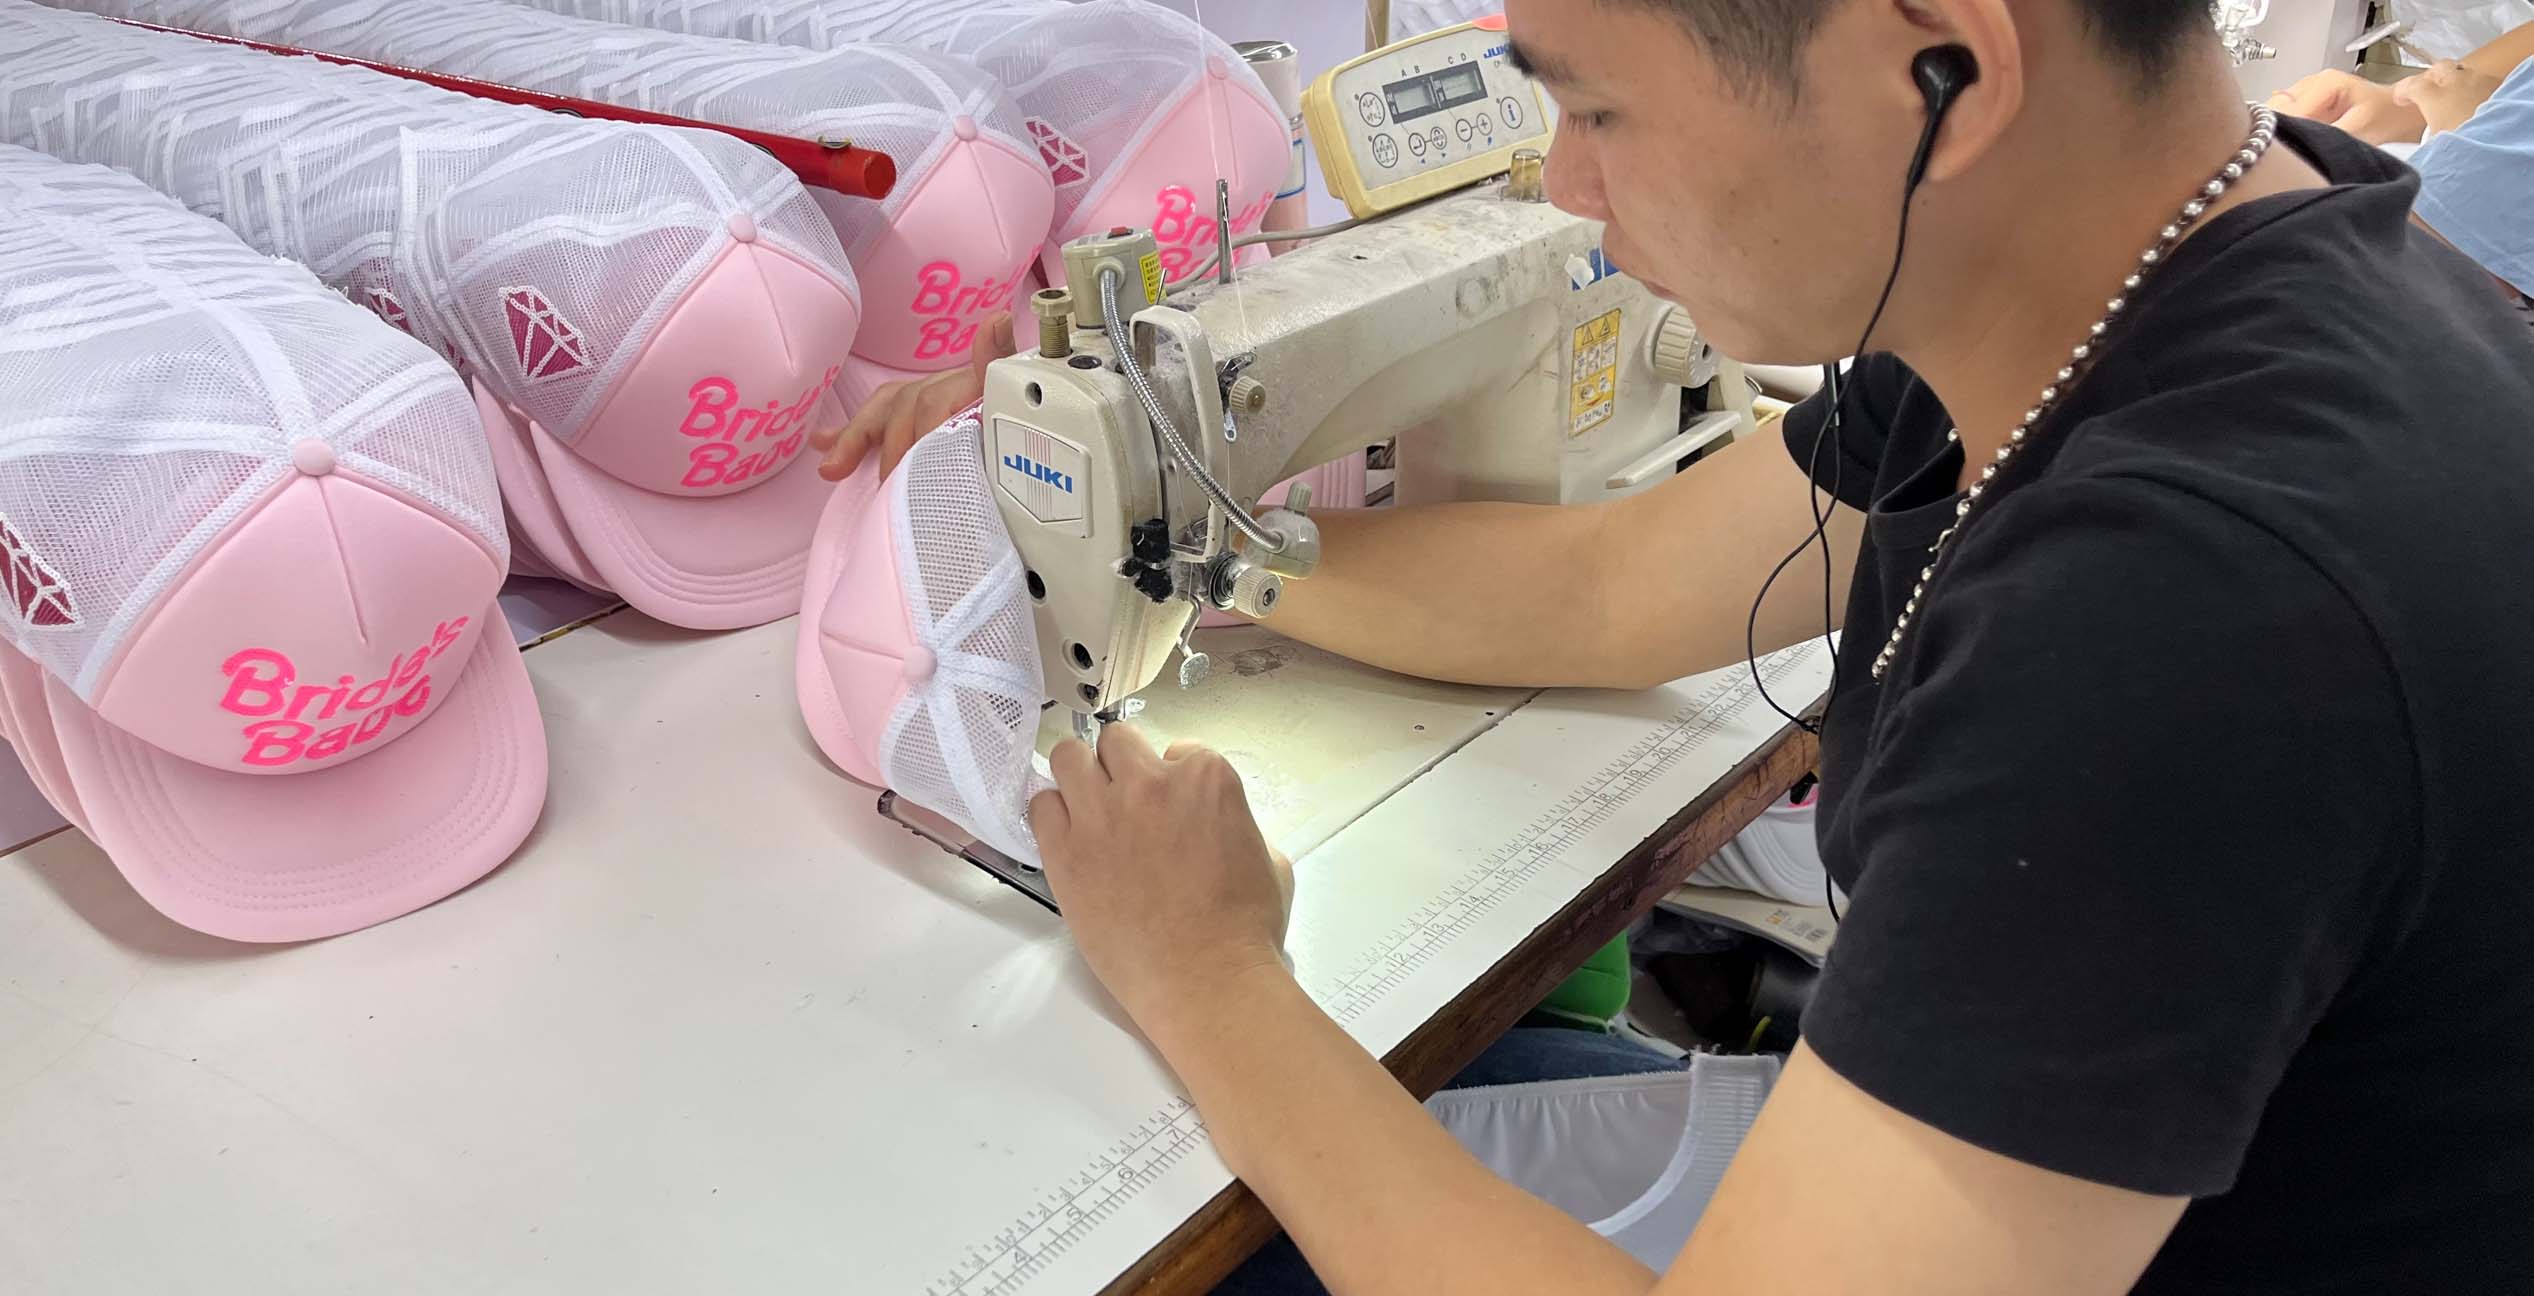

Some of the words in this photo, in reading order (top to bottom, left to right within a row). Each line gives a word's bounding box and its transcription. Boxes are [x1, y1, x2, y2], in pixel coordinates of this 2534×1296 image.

[1401, 69, 1407, 78] A
[1415, 65, 1421, 74] B
[1447, 56, 1454, 65] C
[1460, 52, 1467, 61] D
[914, 317, 980, 359] Ba
[1004, 454, 1073, 494] JUKI
[219, 615, 470, 720] Bride's
[1386, 952, 1408, 968] 12
[1423, 922, 1445, 938] 13
[1459, 895, 1480, 909] 14
[1494, 867, 1516, 881] 15
[1528, 842, 1549, 856] 16
[1561, 815, 1580, 830] 17
[1592, 792, 1613, 806] 18
[1623, 768, 1643, 782] 19
[1651, 746, 1672, 761] 20
[1707, 703, 1728, 717] 22
[1013, 1248, 1030, 1265] 4
[1066, 1206, 1082, 1222] 5
[1117, 1166, 1134, 1181] 6
[1166, 1128, 1180, 1141] 7
